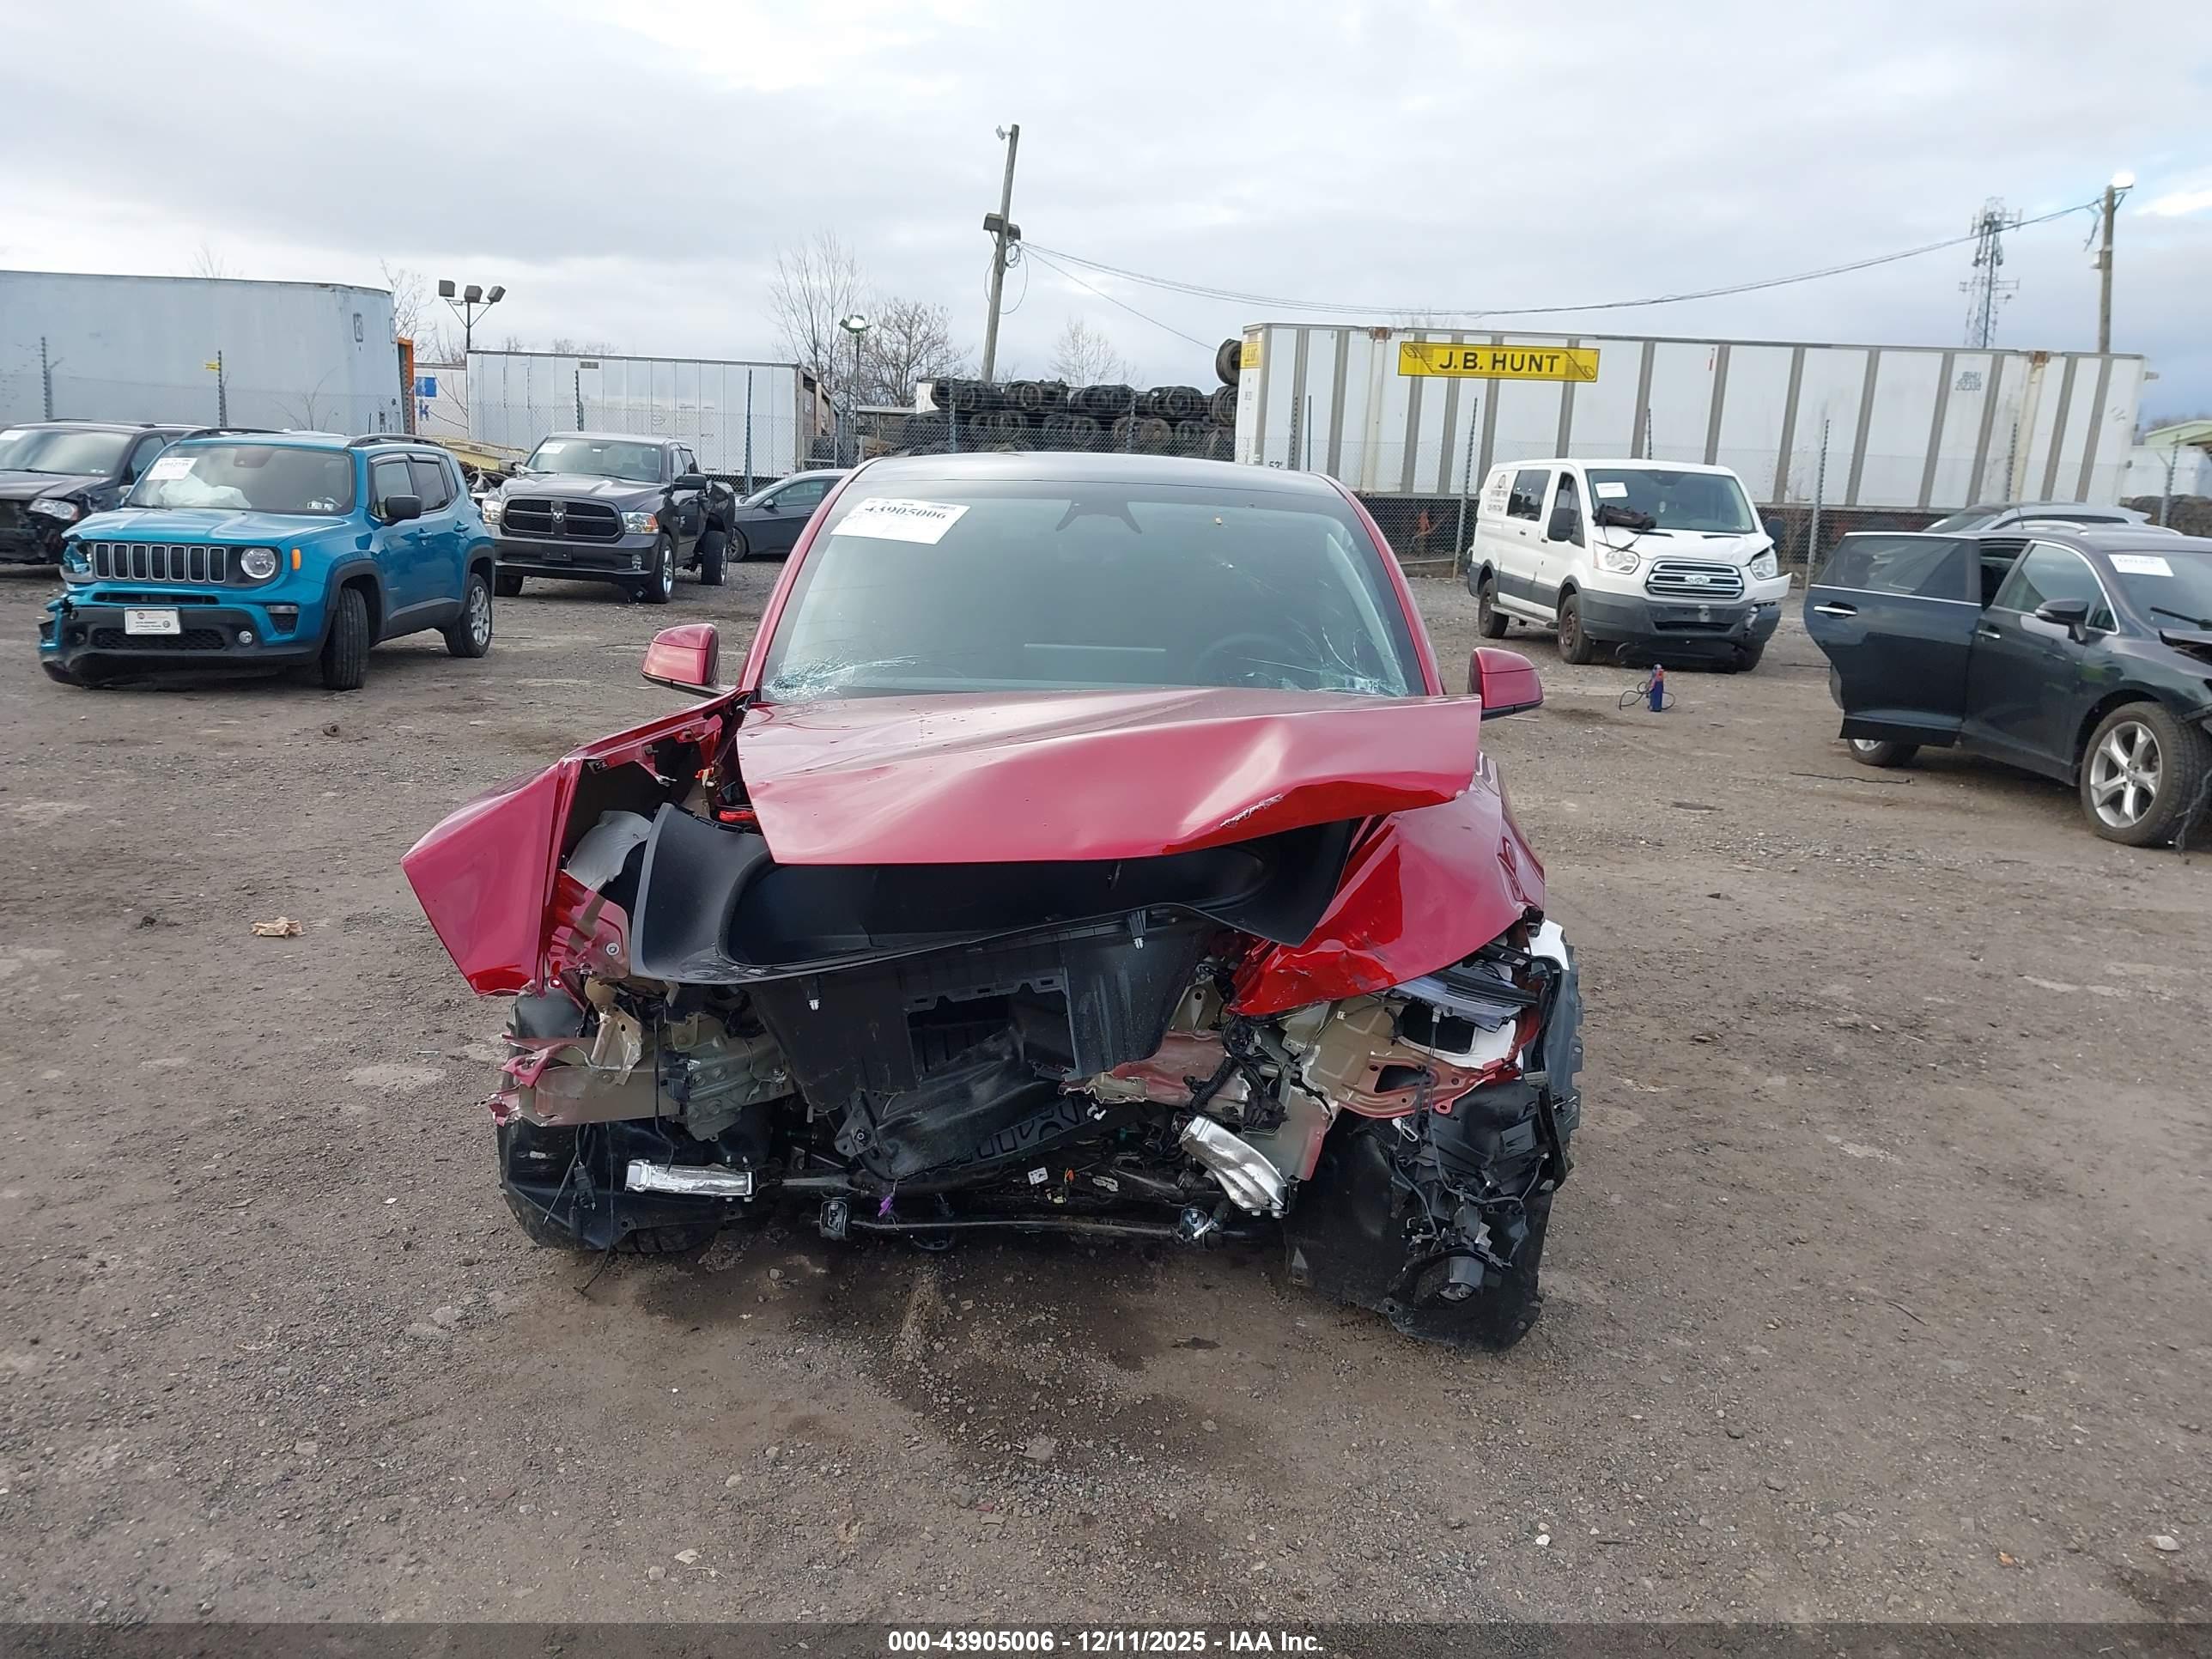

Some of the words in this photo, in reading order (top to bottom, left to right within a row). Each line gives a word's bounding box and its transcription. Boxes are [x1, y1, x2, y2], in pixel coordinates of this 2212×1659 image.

[1439, 350, 1484, 371] J.B.
[1491, 352, 1560, 373] HUNT
[864, 505, 946, 520] 43905006
